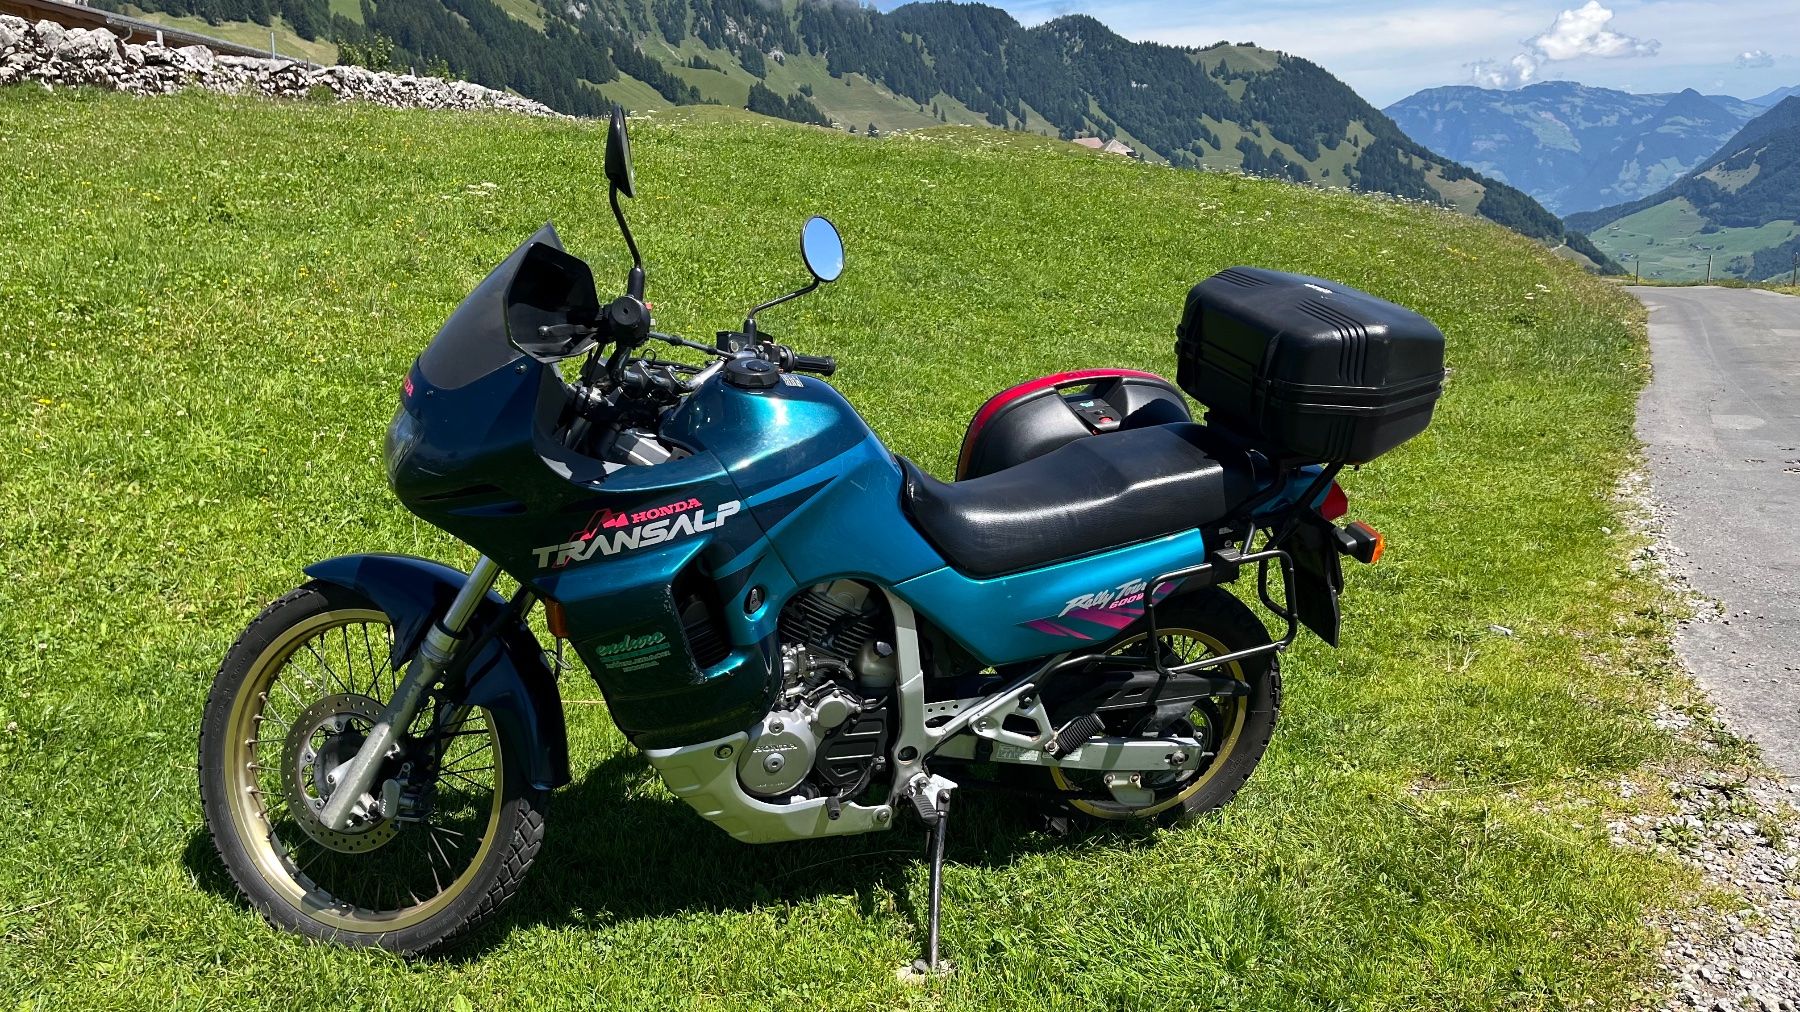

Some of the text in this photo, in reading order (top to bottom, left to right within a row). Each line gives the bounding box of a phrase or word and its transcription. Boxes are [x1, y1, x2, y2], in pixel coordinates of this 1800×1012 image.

[631, 497, 702, 524] HONDA
[532, 499, 742, 569] TRANSALP
[1058, 588, 1114, 618] Rally
